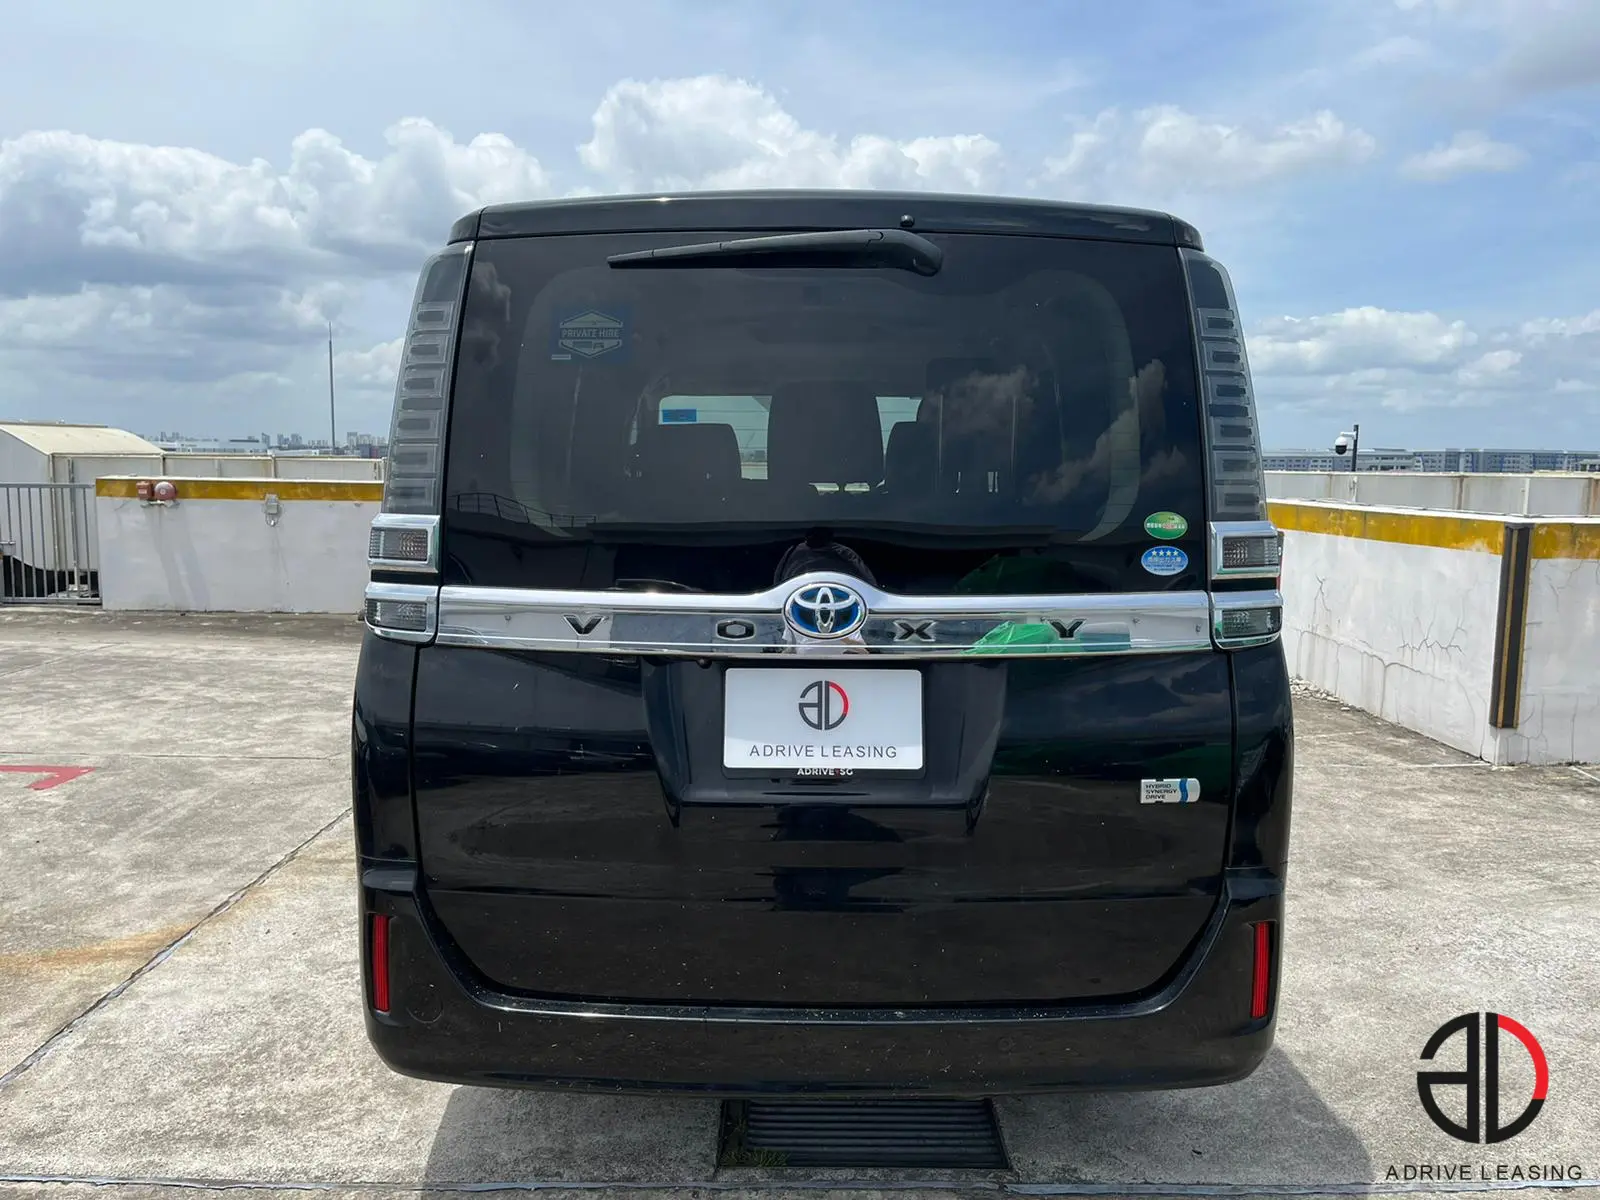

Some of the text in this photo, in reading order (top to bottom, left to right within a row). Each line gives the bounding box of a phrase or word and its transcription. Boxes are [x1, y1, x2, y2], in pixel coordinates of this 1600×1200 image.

[562, 328, 620, 338] PRIVATE HIRE
[749, 744, 897, 758] ADRIVE LEASING
[796, 767, 835, 776] ADRIVE
